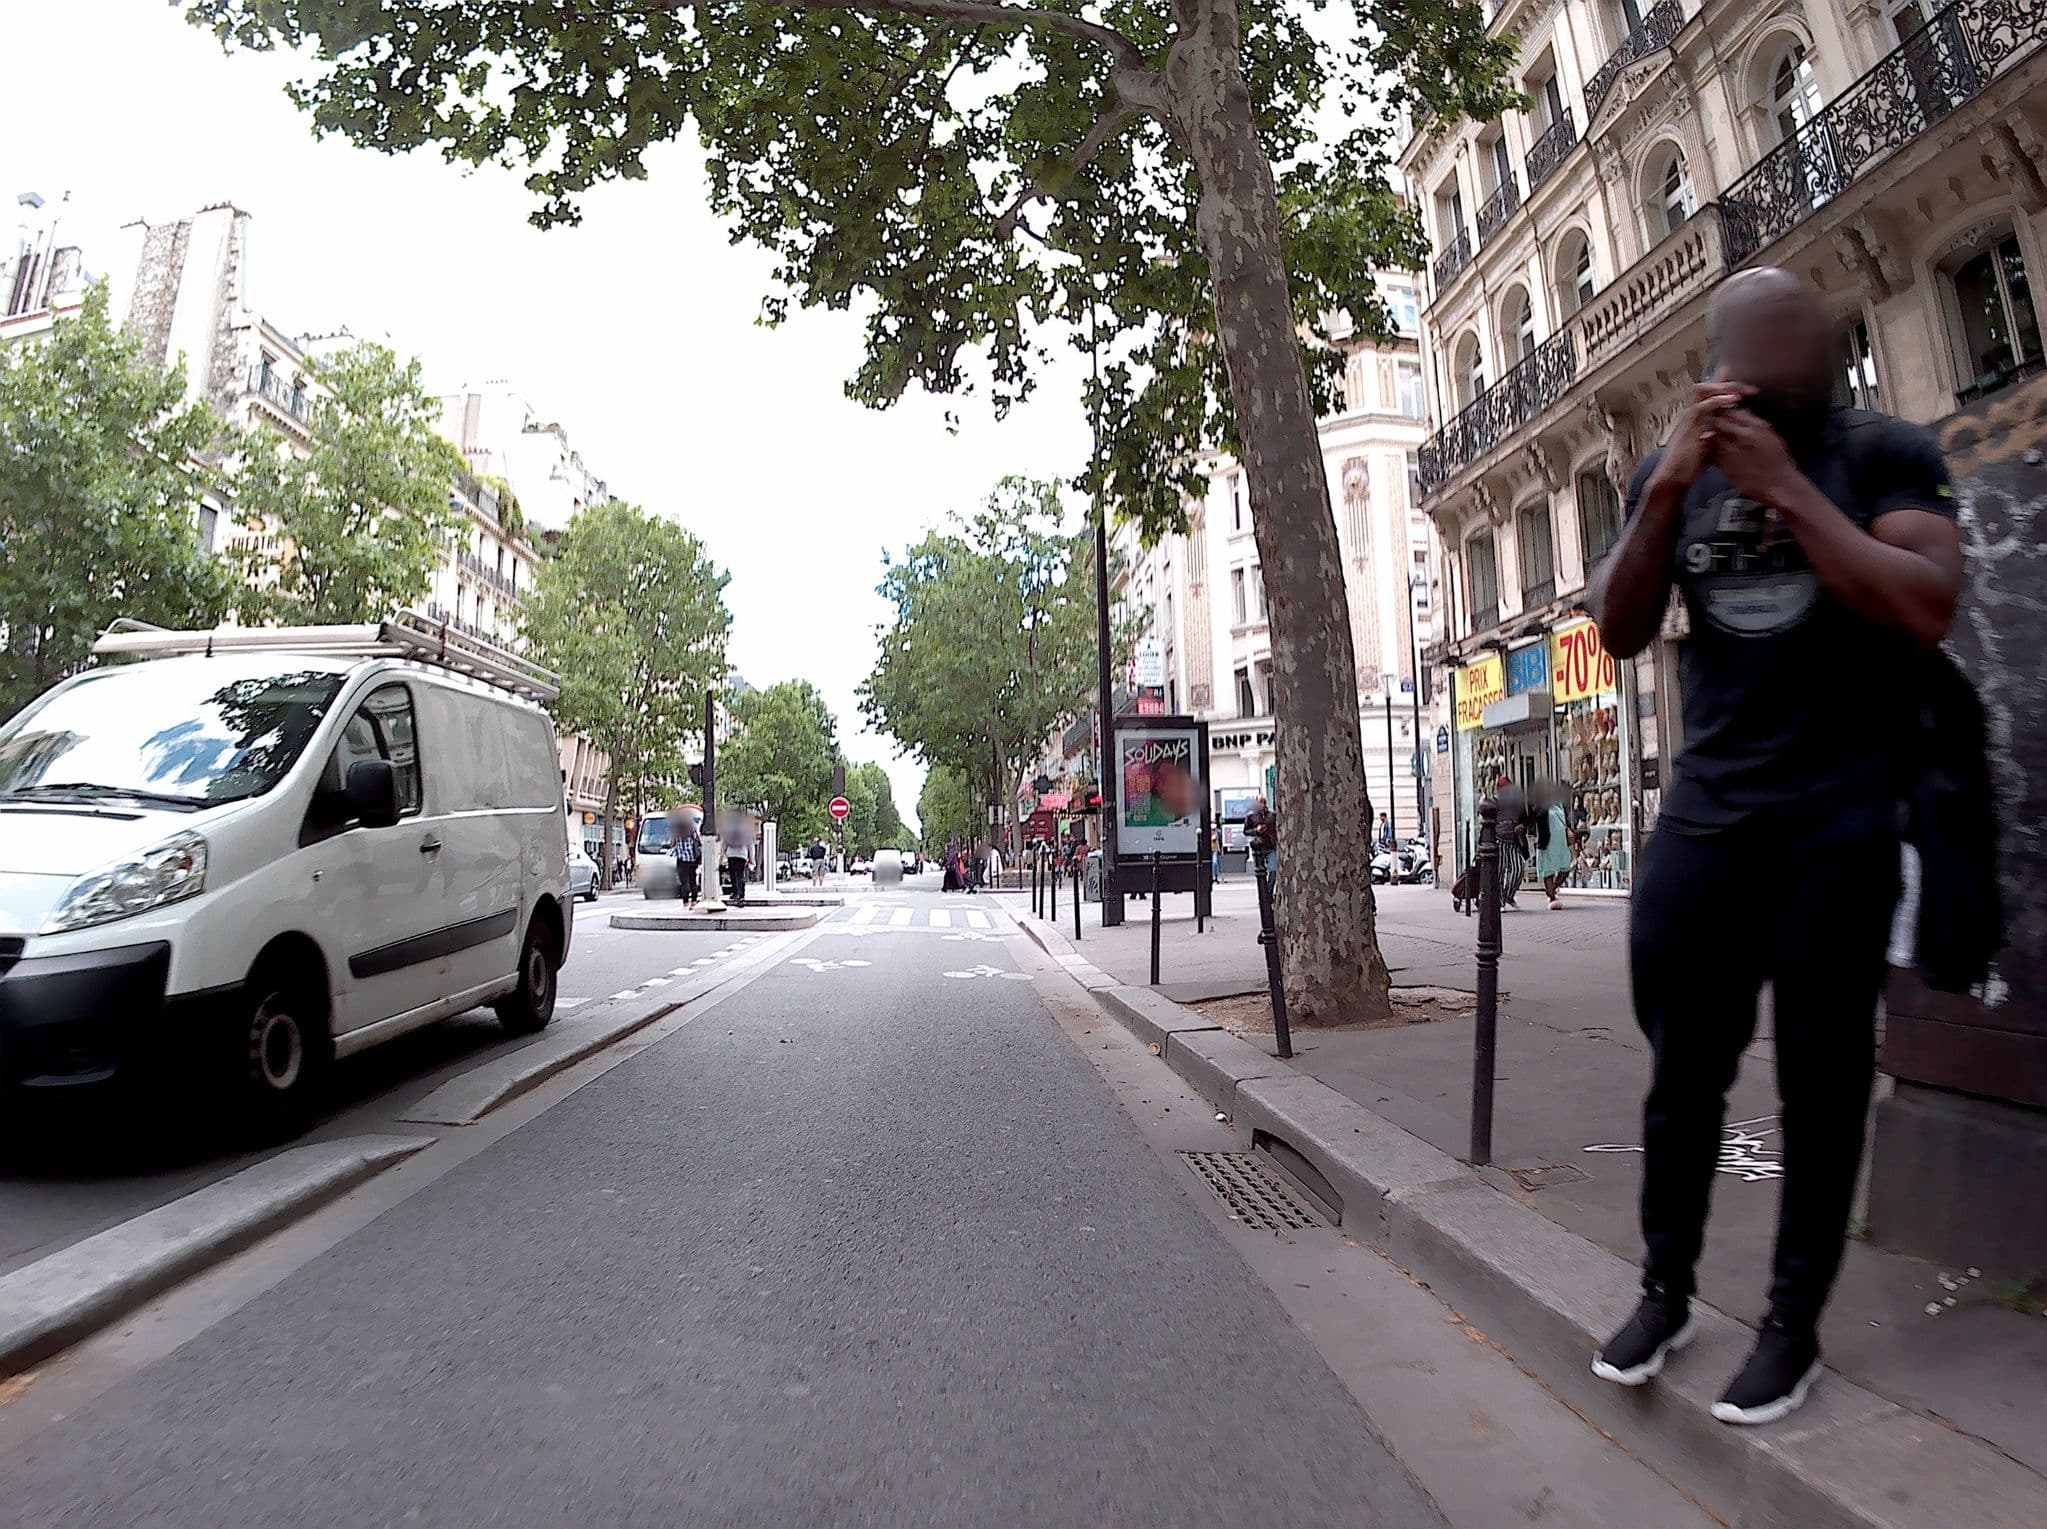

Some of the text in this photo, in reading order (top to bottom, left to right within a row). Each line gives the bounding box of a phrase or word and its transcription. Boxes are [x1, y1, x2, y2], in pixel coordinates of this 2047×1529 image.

[1556, 625, 1613, 695] -70%
[1469, 665, 1489, 694] PRIX
[1212, 733, 1252, 750] BNP
